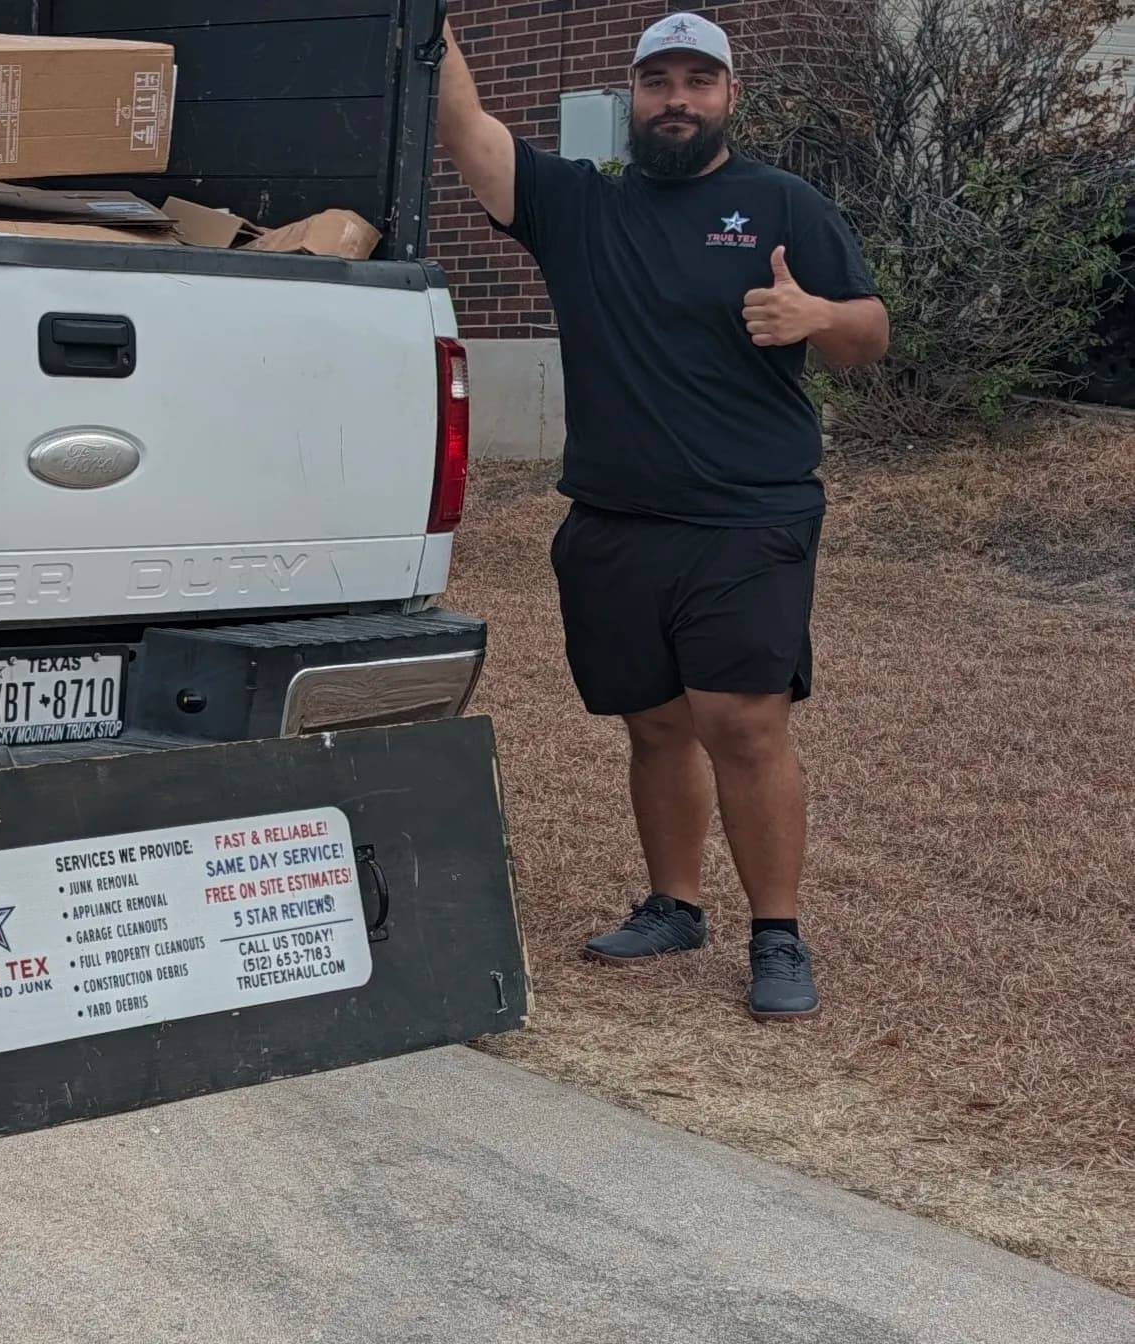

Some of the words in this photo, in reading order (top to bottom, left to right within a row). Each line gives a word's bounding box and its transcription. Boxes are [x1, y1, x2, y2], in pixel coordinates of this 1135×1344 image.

[706, 233, 735, 242] TRUE
[737, 234, 758, 243] TEX
[63, 441, 122, 473] Ford
[125, 553, 309, 600] DUTY
[28, 656, 82, 673] TEXAS
[53, 677, 115, 720] 8710
[16, 723, 65, 744] MOUNTAIN
[66, 721, 98, 741] TRUCK
[98, 719, 123, 738] STOP
[214, 831, 246, 850] FAST
[251, 830, 261, 844] &
[264, 821, 328, 842] RELIABLE!
[55, 850, 116, 873] SERVICES
[118, 847, 137, 864] WE
[140, 839, 193, 861] PROVIDE:
[205, 856, 246, 878] SAME
[250, 852, 280, 872] DAY
[284, 843, 344, 866] SERVICE!
[69, 879, 94, 896] JUNK
[96, 873, 140, 892] REMOVAL
[205, 885, 237, 904] FREE
[239, 882, 257, 899] ON
[260, 877, 286, 896] SITE
[288, 867, 353, 892] ESTIMATES!
[72, 898, 124, 920] APPLIANCE
[126, 893, 168, 913] REMOVAL
[234, 911, 243, 928] 5
[247, 906, 279, 925] STAR
[282, 896, 336, 920] REVIEWS!
[76, 926, 113, 945] GARAGE
[116, 917, 168, 939] CLEANOUTS
[238, 939, 270, 956] CALL
[272, 935, 289, 951] US
[292, 928, 334, 948] TODAY!
[79, 953, 102, 969] FULL
[105, 945, 151, 965] PROPERTY
[154, 936, 206, 957] CLEANOUTS
[243, 955, 272, 973] (512)
[276, 945, 332, 968] 653-7183
[5, 956, 50, 981] TEX
[83, 969, 153, 994] CONSTRUCTION
[156, 963, 189, 981] DEBRIS
[236, 958, 346, 991] TRUETEXHAUL.COM
[18, 979, 53, 996] JUNK
[86, 1001, 112, 1018] YARD
[115, 994, 149, 1014] DEBRIS
